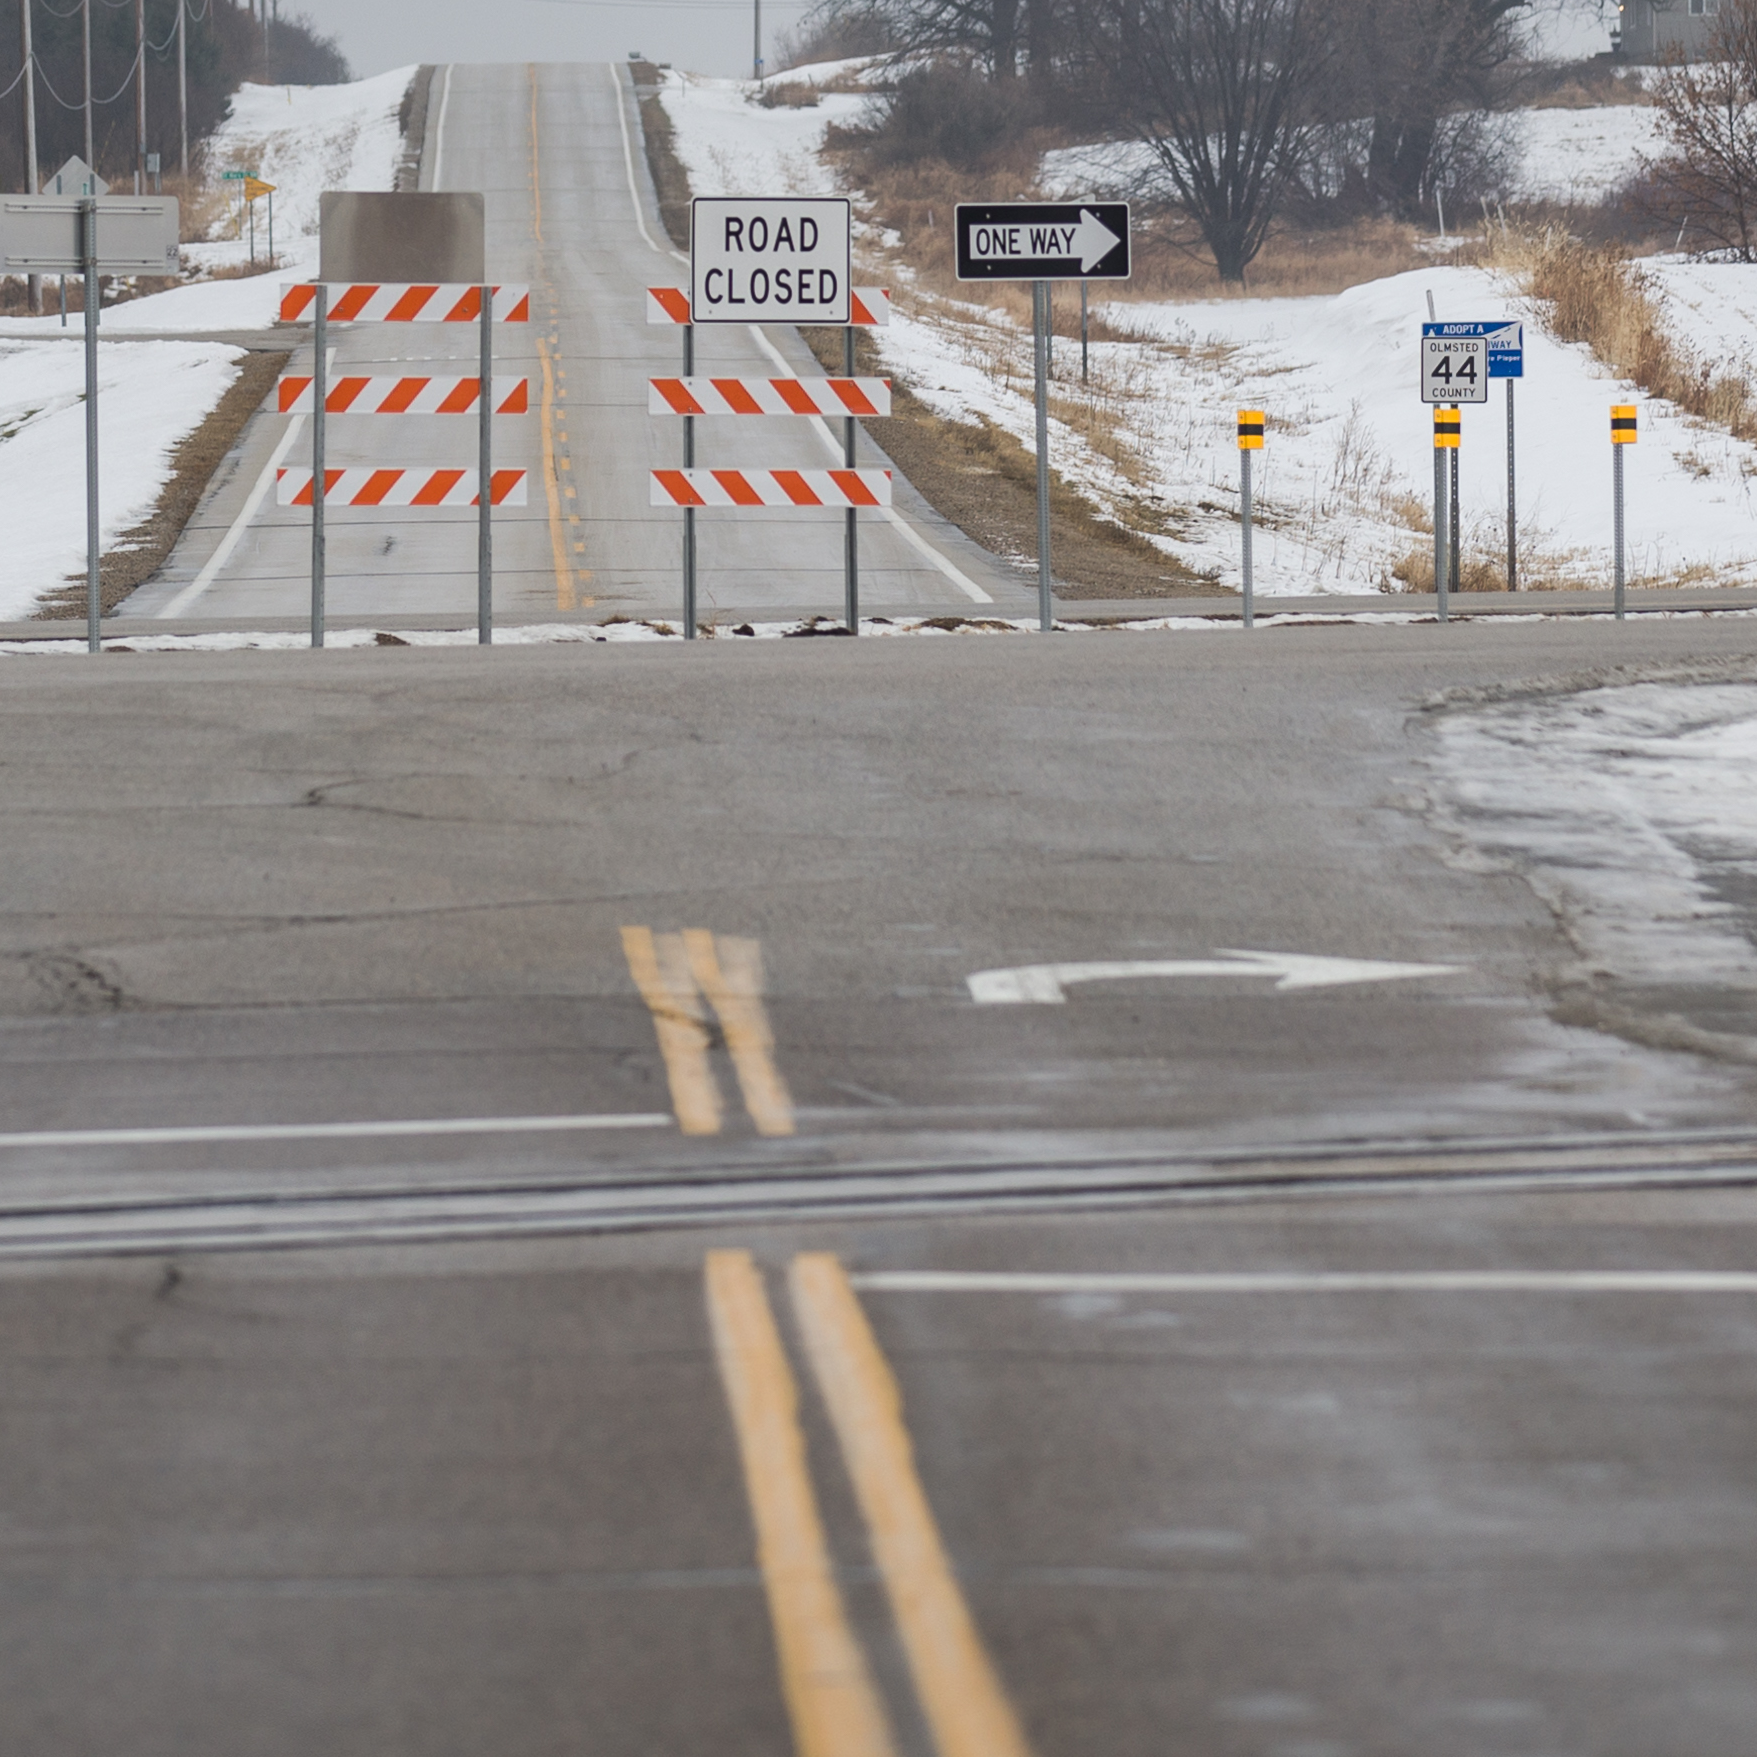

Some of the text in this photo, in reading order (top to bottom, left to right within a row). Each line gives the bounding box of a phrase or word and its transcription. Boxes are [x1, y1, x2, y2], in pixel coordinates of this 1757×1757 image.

[724, 216, 820, 253] ROAD
[975, 227, 1077, 255] ONE WAY
[704, 268, 838, 304] CLOSED
[1443, 324, 1484, 334] ADOPT A
[1430, 342, 1479, 353] OLMSTED
[1431, 355, 1477, 385] 44
[1432, 388, 1476, 397] COUNTY
